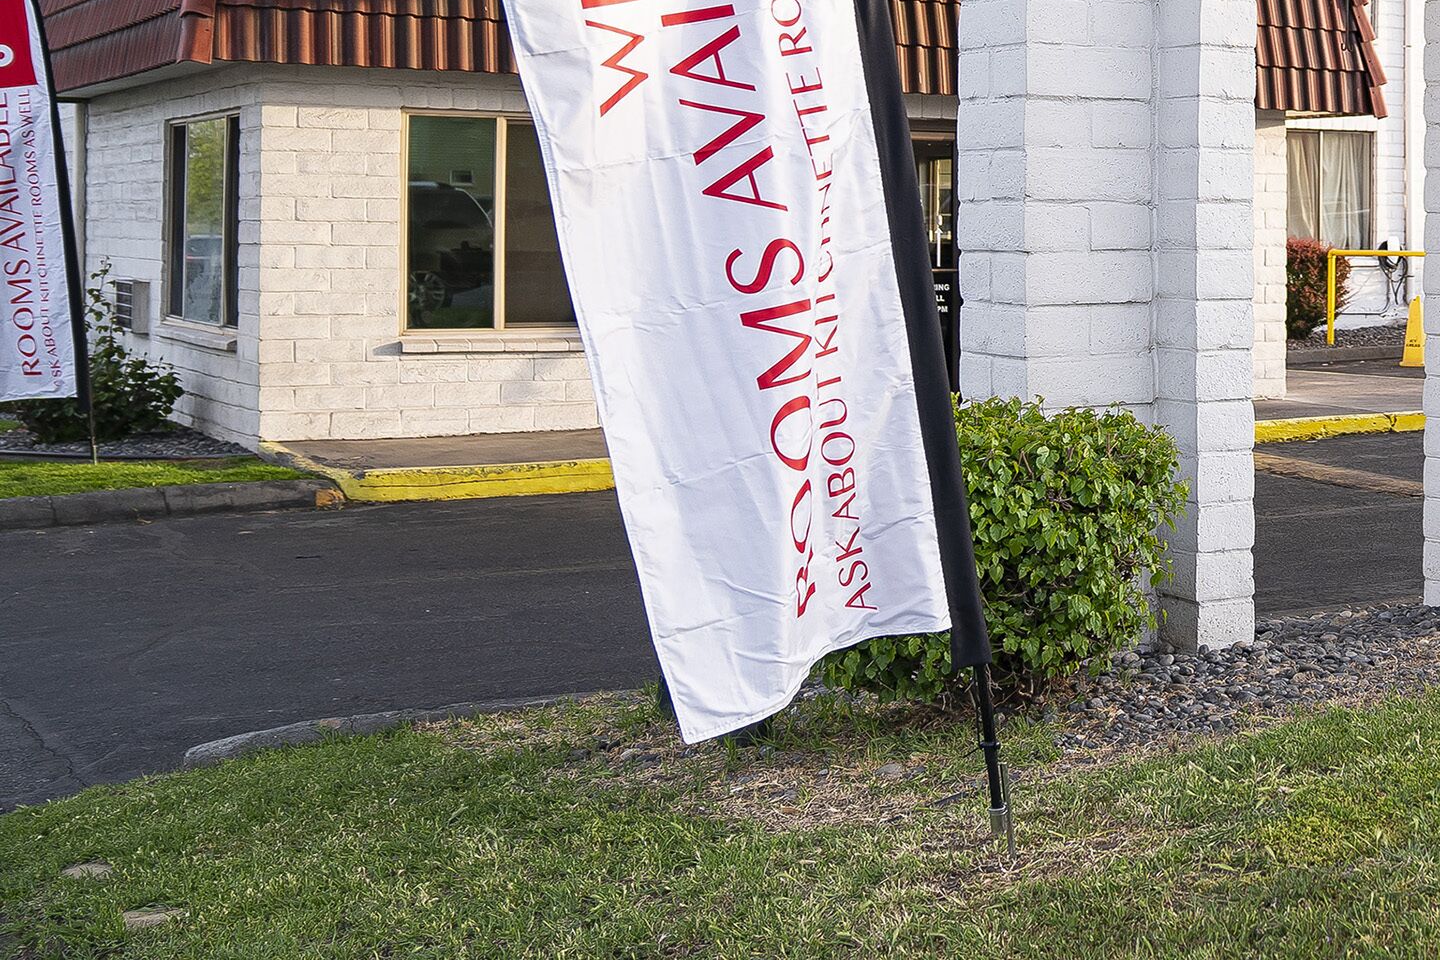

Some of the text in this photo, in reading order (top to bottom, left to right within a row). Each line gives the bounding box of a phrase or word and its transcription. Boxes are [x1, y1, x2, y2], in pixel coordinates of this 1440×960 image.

[18, 90, 34, 127] WELL
[21, 129, 37, 148] AS
[25, 151, 42, 206] ROOMS
[4, 258, 42, 376] ROOMS
[40, 308, 58, 357] ABOUT
[726, 238, 815, 617] ROOMS
[816, 372, 859, 520] ABOUT
[836, 526, 878, 610] ASK
